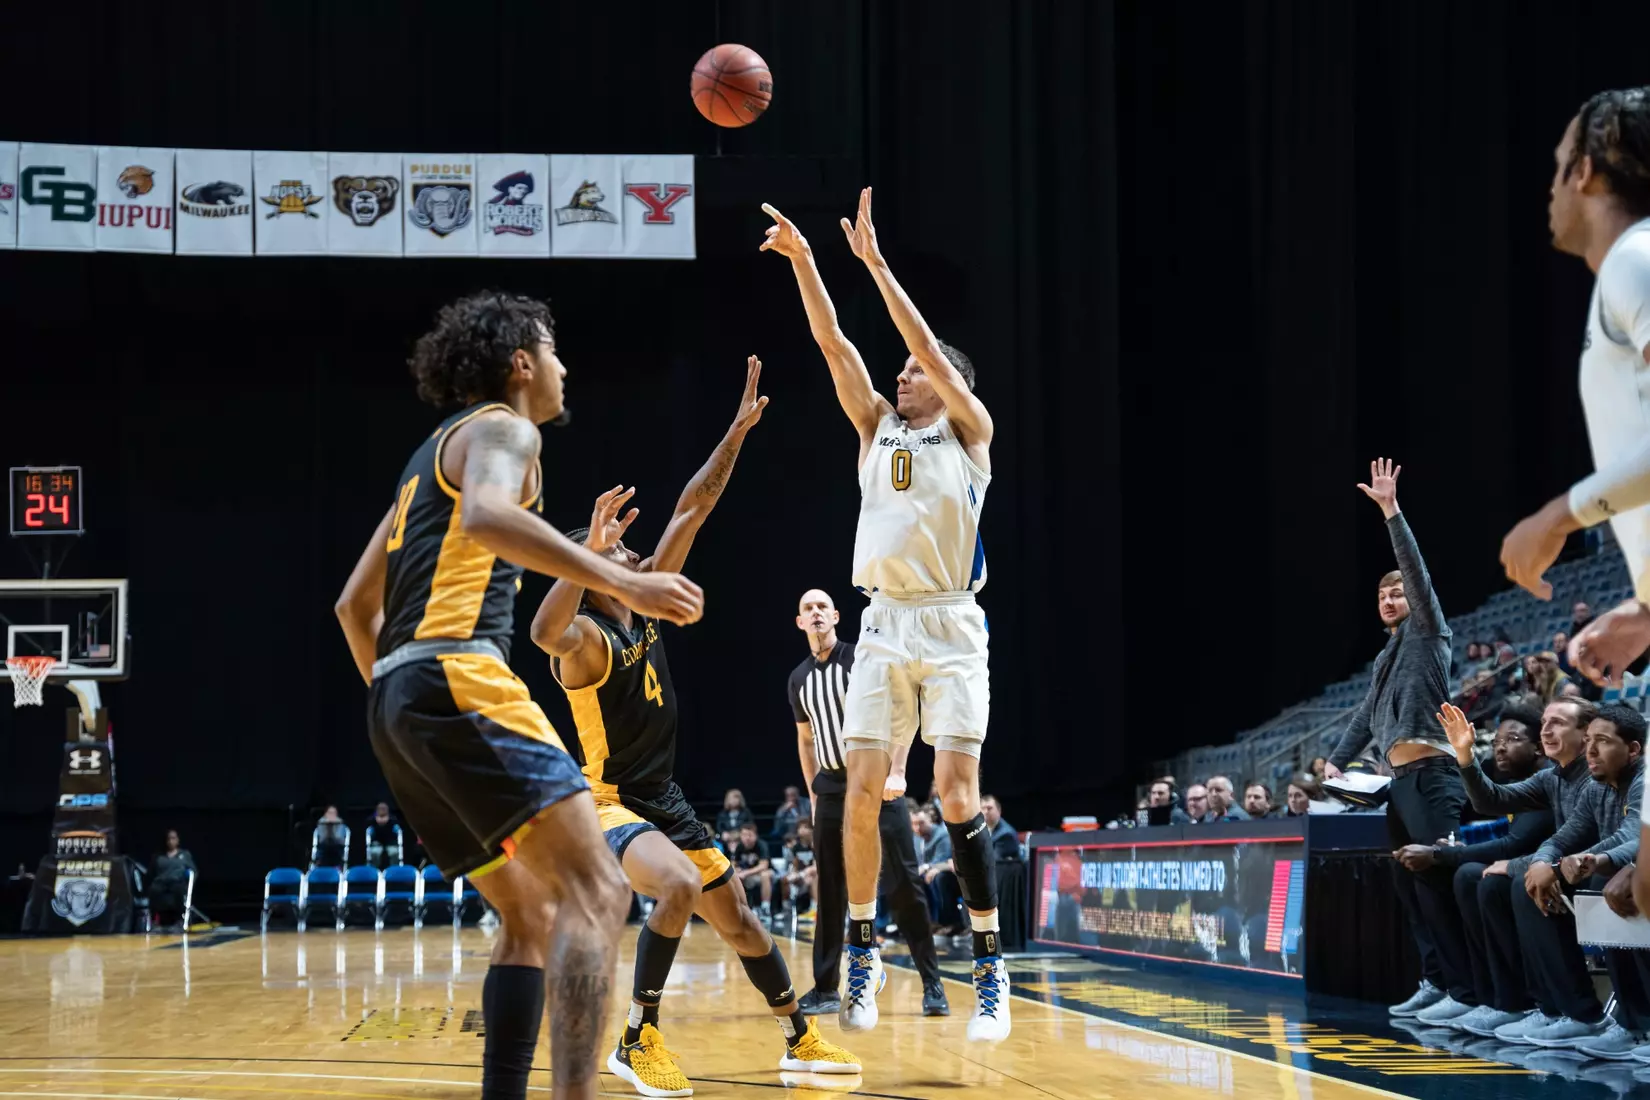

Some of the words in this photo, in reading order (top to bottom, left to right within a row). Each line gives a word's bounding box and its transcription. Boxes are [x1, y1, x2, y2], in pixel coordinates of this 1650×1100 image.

[410, 164, 472, 175] PURDUE
[21, 166, 96, 222] GB
[625, 184, 692, 224] Y
[98, 203, 171, 230] IUPUI
[180, 202, 250, 219] MILWAUKEE
[484, 203, 543, 216] ROBERT
[484, 214, 543, 232] MORRIS
[891, 448, 913, 491] 0
[25, 494, 69, 527] 24
[644, 660, 664, 707] 4
[57, 838, 107, 848] HORIZON
[1181, 860, 1211, 891] NAMED
[1212, 860, 1226, 892] TO
